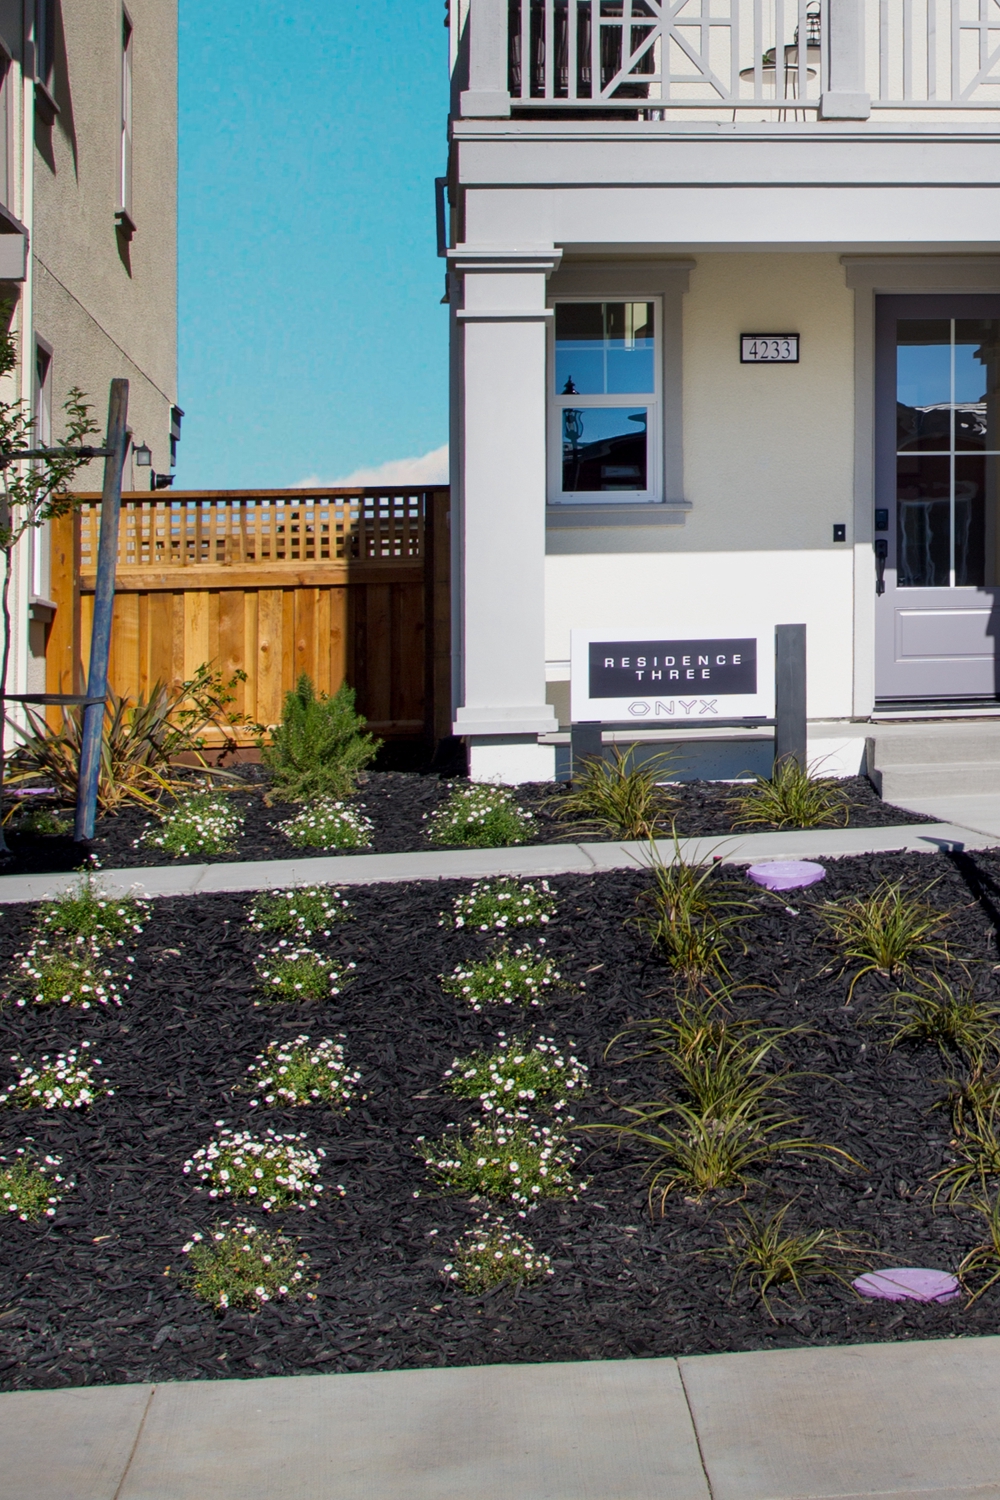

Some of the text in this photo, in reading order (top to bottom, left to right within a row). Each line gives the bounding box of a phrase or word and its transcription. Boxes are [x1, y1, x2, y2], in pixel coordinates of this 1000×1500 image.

[748, 340, 791, 359] 4233
[604, 654, 742, 668] RESIDENCE
[635, 668, 711, 681] THREE
[628, 699, 718, 716] ONYX
